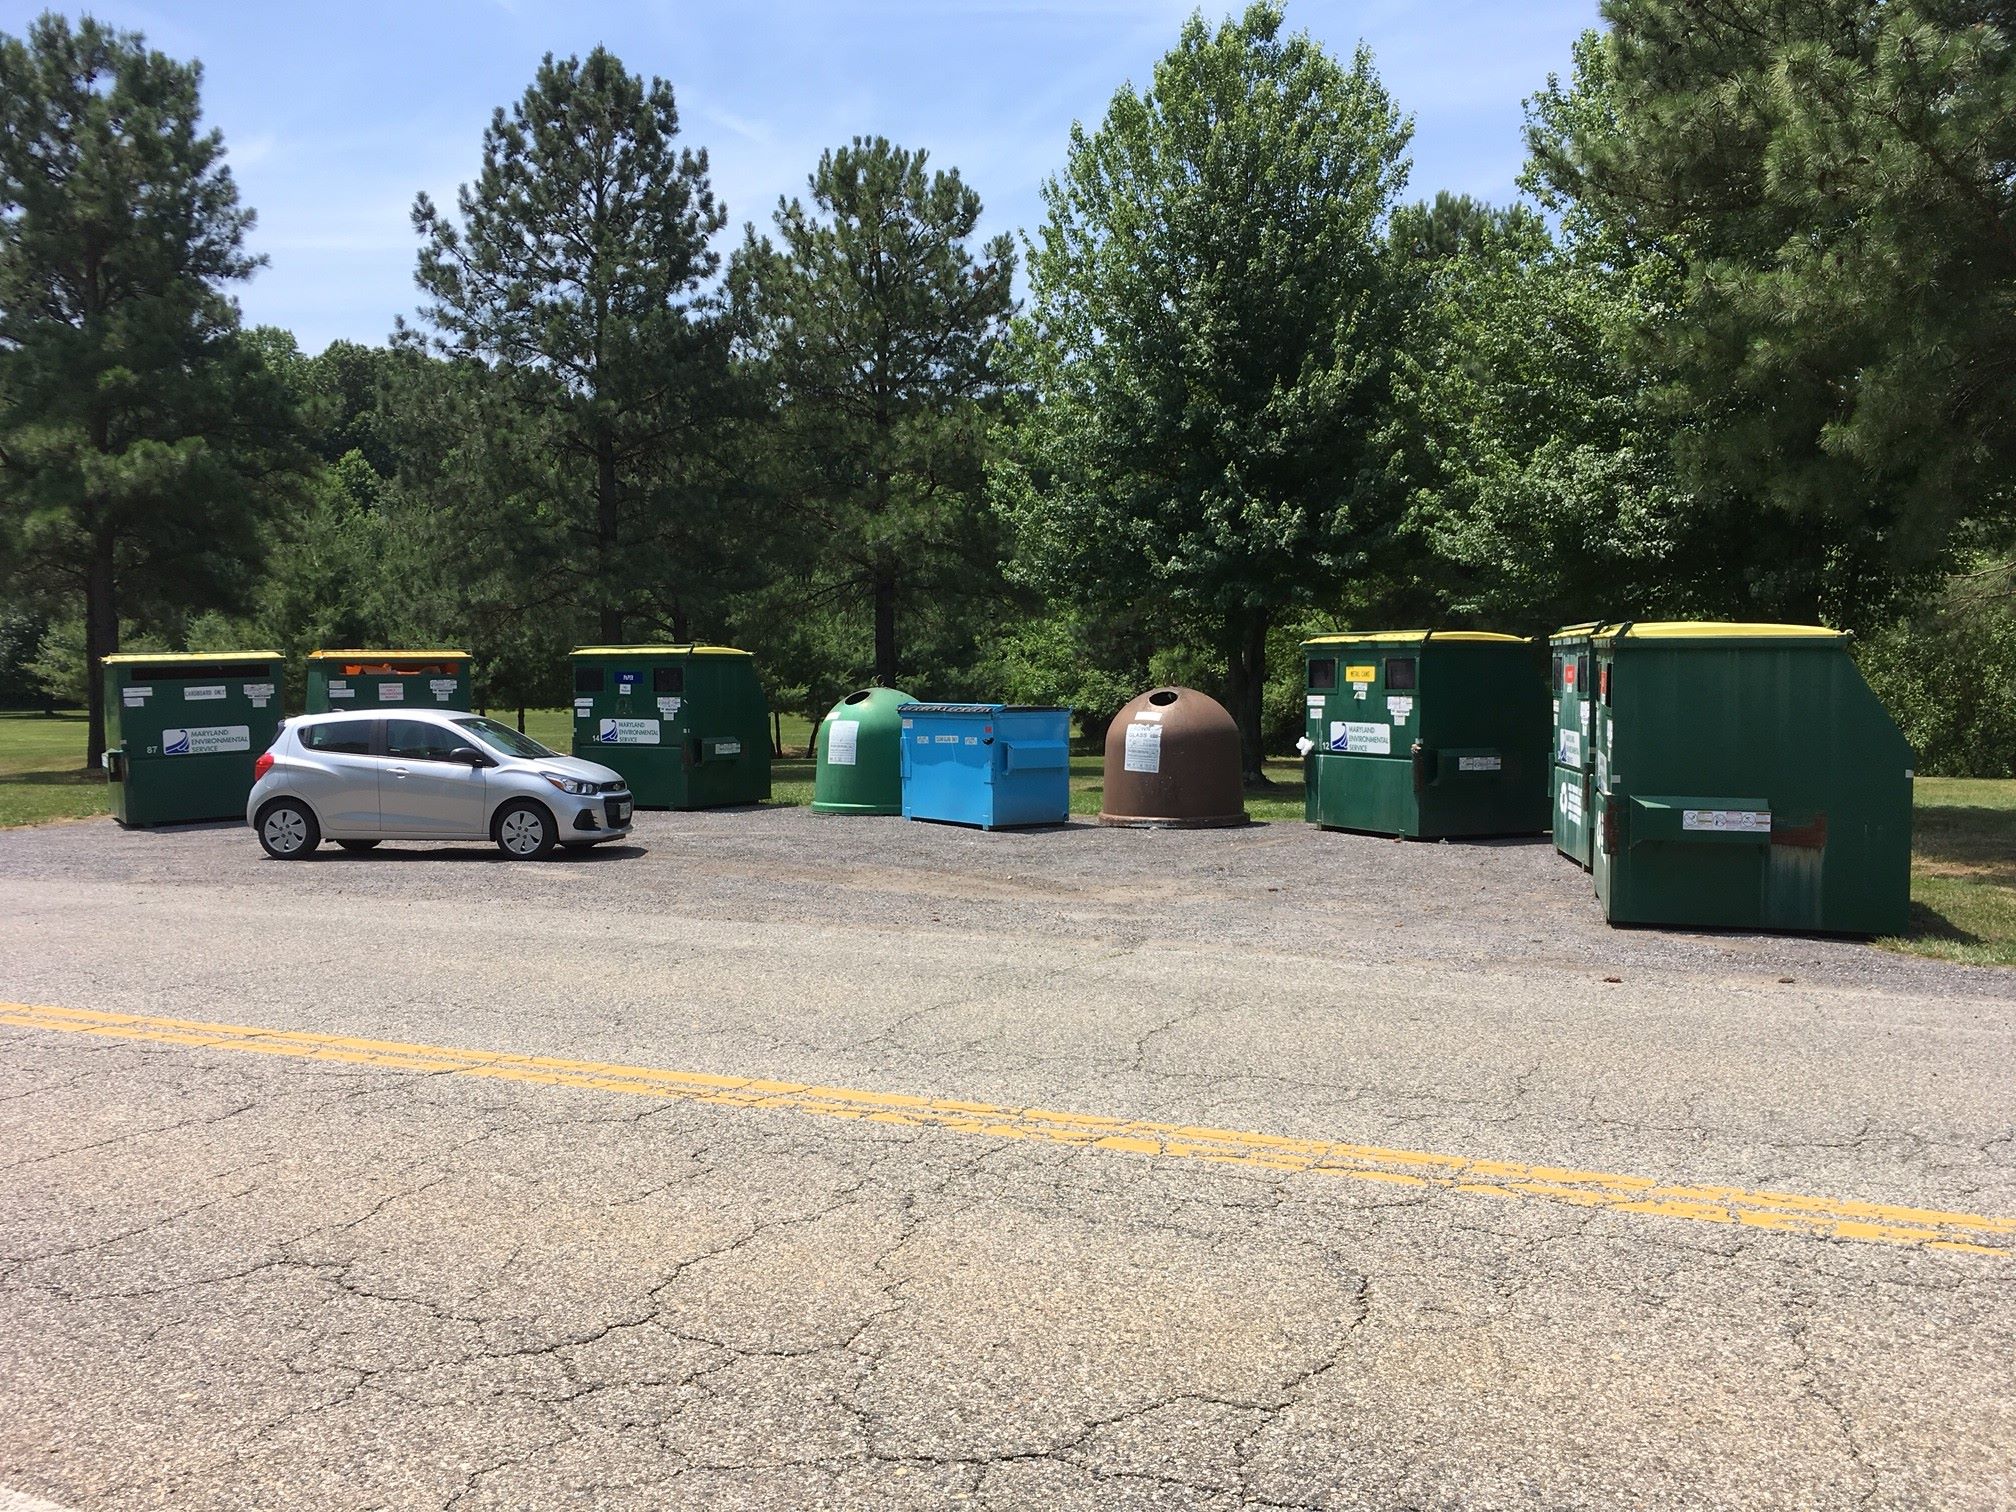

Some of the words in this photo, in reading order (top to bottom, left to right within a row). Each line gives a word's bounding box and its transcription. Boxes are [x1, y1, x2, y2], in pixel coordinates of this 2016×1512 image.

[191, 729, 229, 737] MARYLAND
[1348, 726, 1376, 734] MARYLAND
[191, 737, 248, 745] ENVIRONMENTAL
[1348, 735, 1389, 744] ENVIRONMENTAL
[146, 745, 158, 754] 87
[1322, 742, 1330, 750] 12
